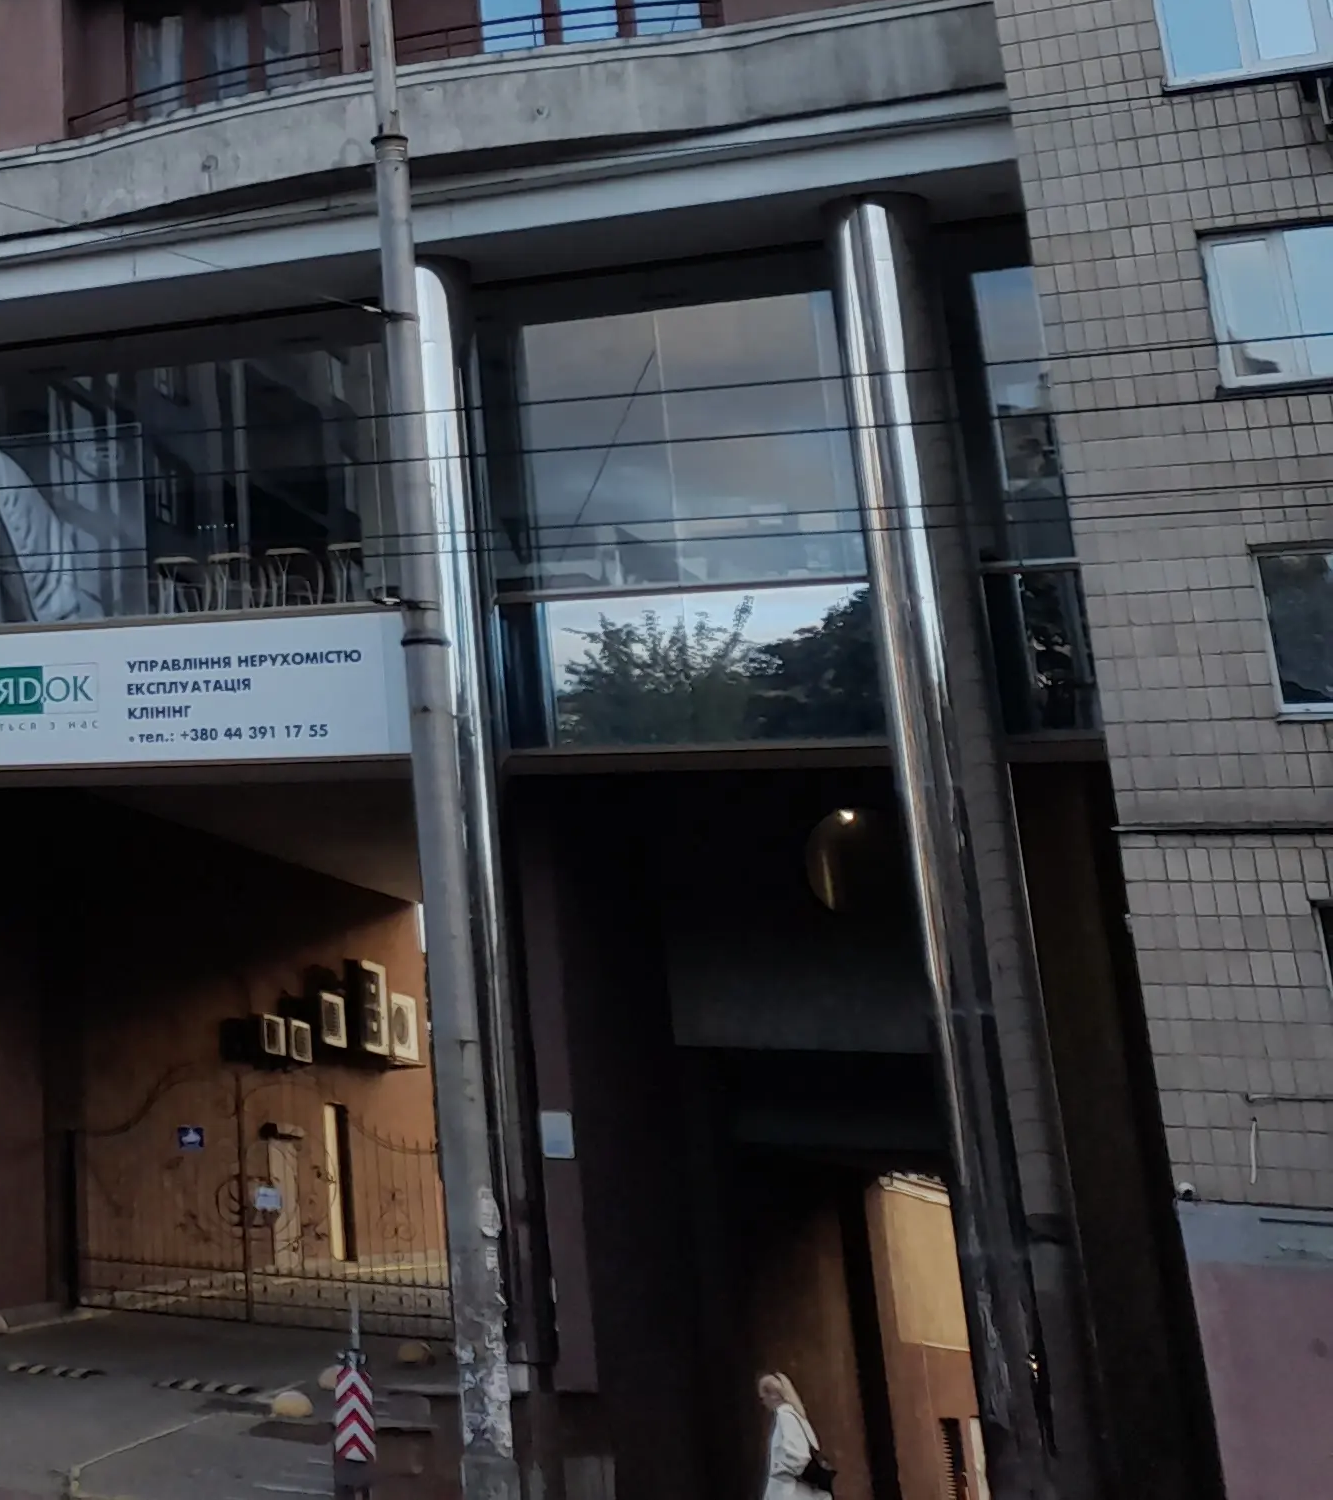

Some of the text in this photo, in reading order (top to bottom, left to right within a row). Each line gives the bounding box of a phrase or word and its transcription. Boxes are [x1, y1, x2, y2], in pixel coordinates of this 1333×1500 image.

[126, 649, 362, 675] УПРАВЛІННЯ НЕРУХОМІСТЮ
[126, 678, 252, 696] ЕКСПЛУАТАЦІЯ
[127, 705, 192, 720] КЛІНІНГ
[180, 727, 219, 742] +380
[223, 727, 243, 741] 44
[248, 725, 276, 739] 391
[284, 724, 303, 738] 17
[308, 723, 329, 738] 55
